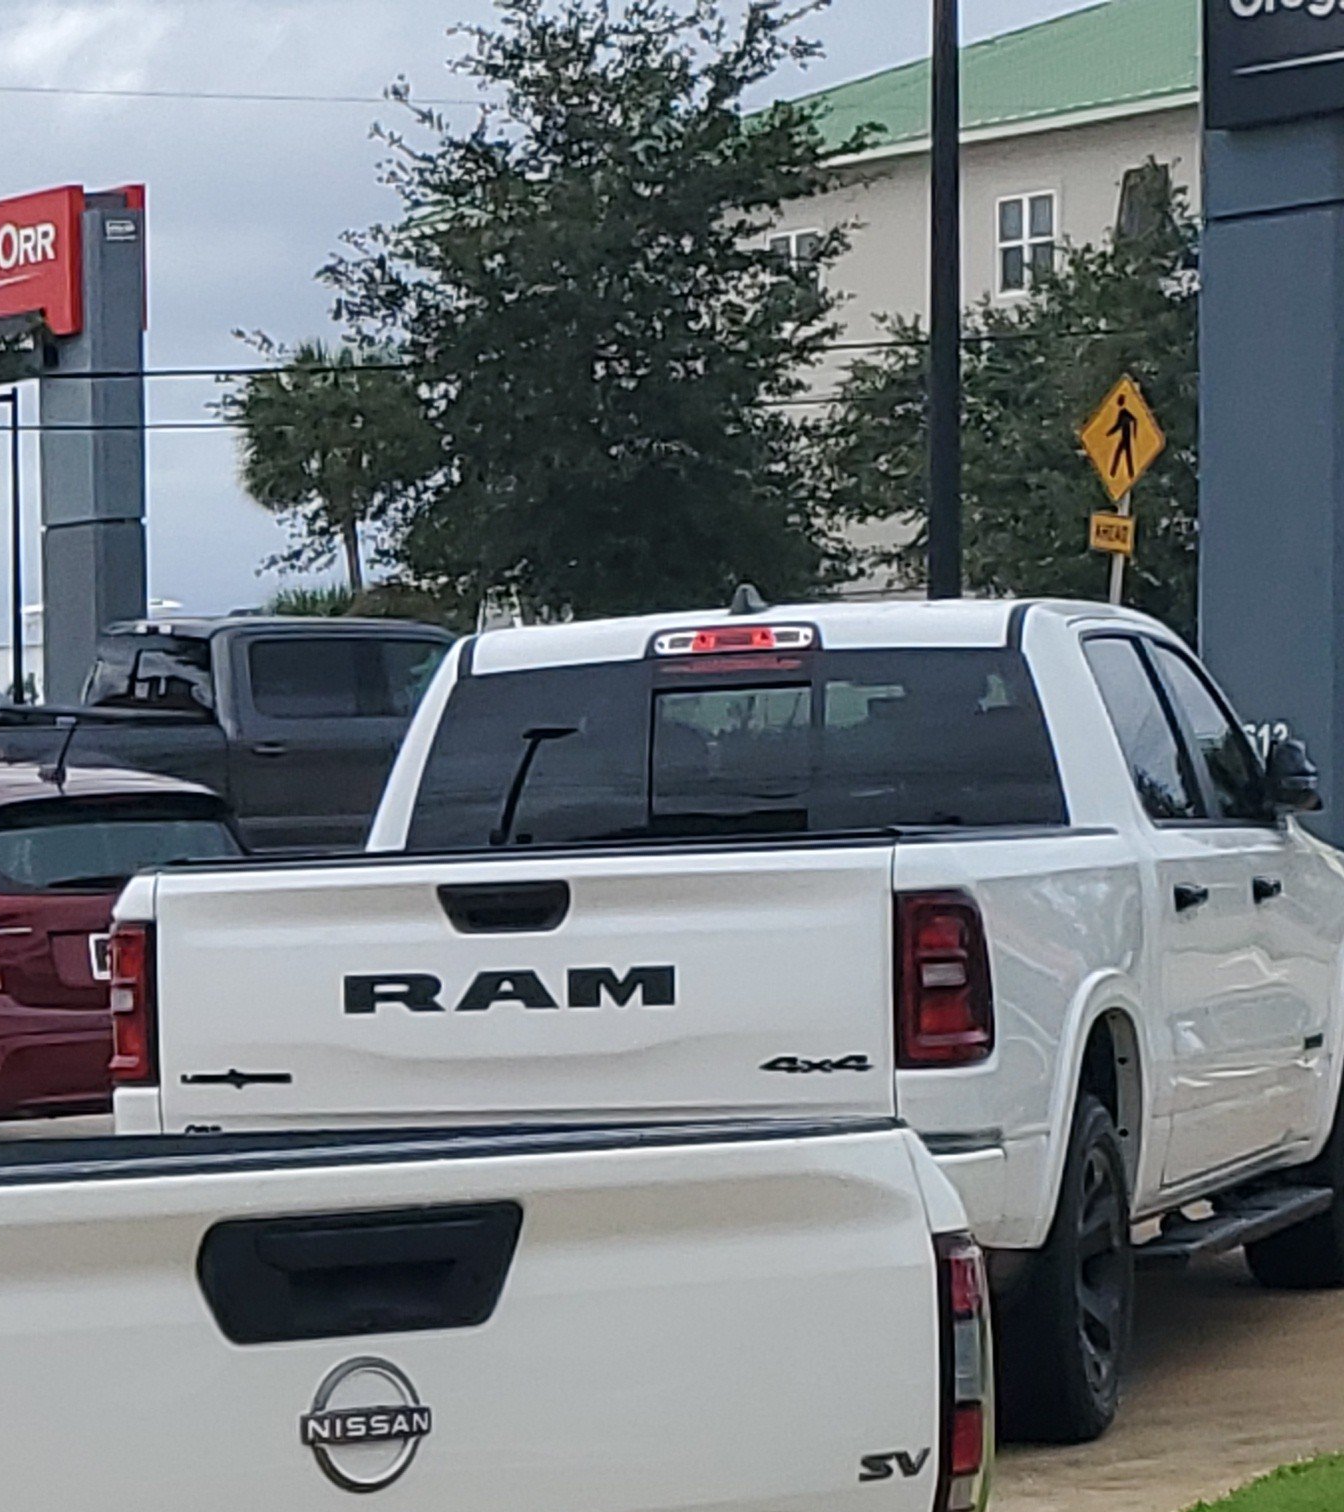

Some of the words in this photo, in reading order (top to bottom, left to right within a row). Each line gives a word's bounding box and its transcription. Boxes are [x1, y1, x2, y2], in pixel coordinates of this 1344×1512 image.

[343, 964, 676, 1015] RAM
[307, 1412, 429, 1442] NISSAN
[858, 1446, 932, 1482] SV
